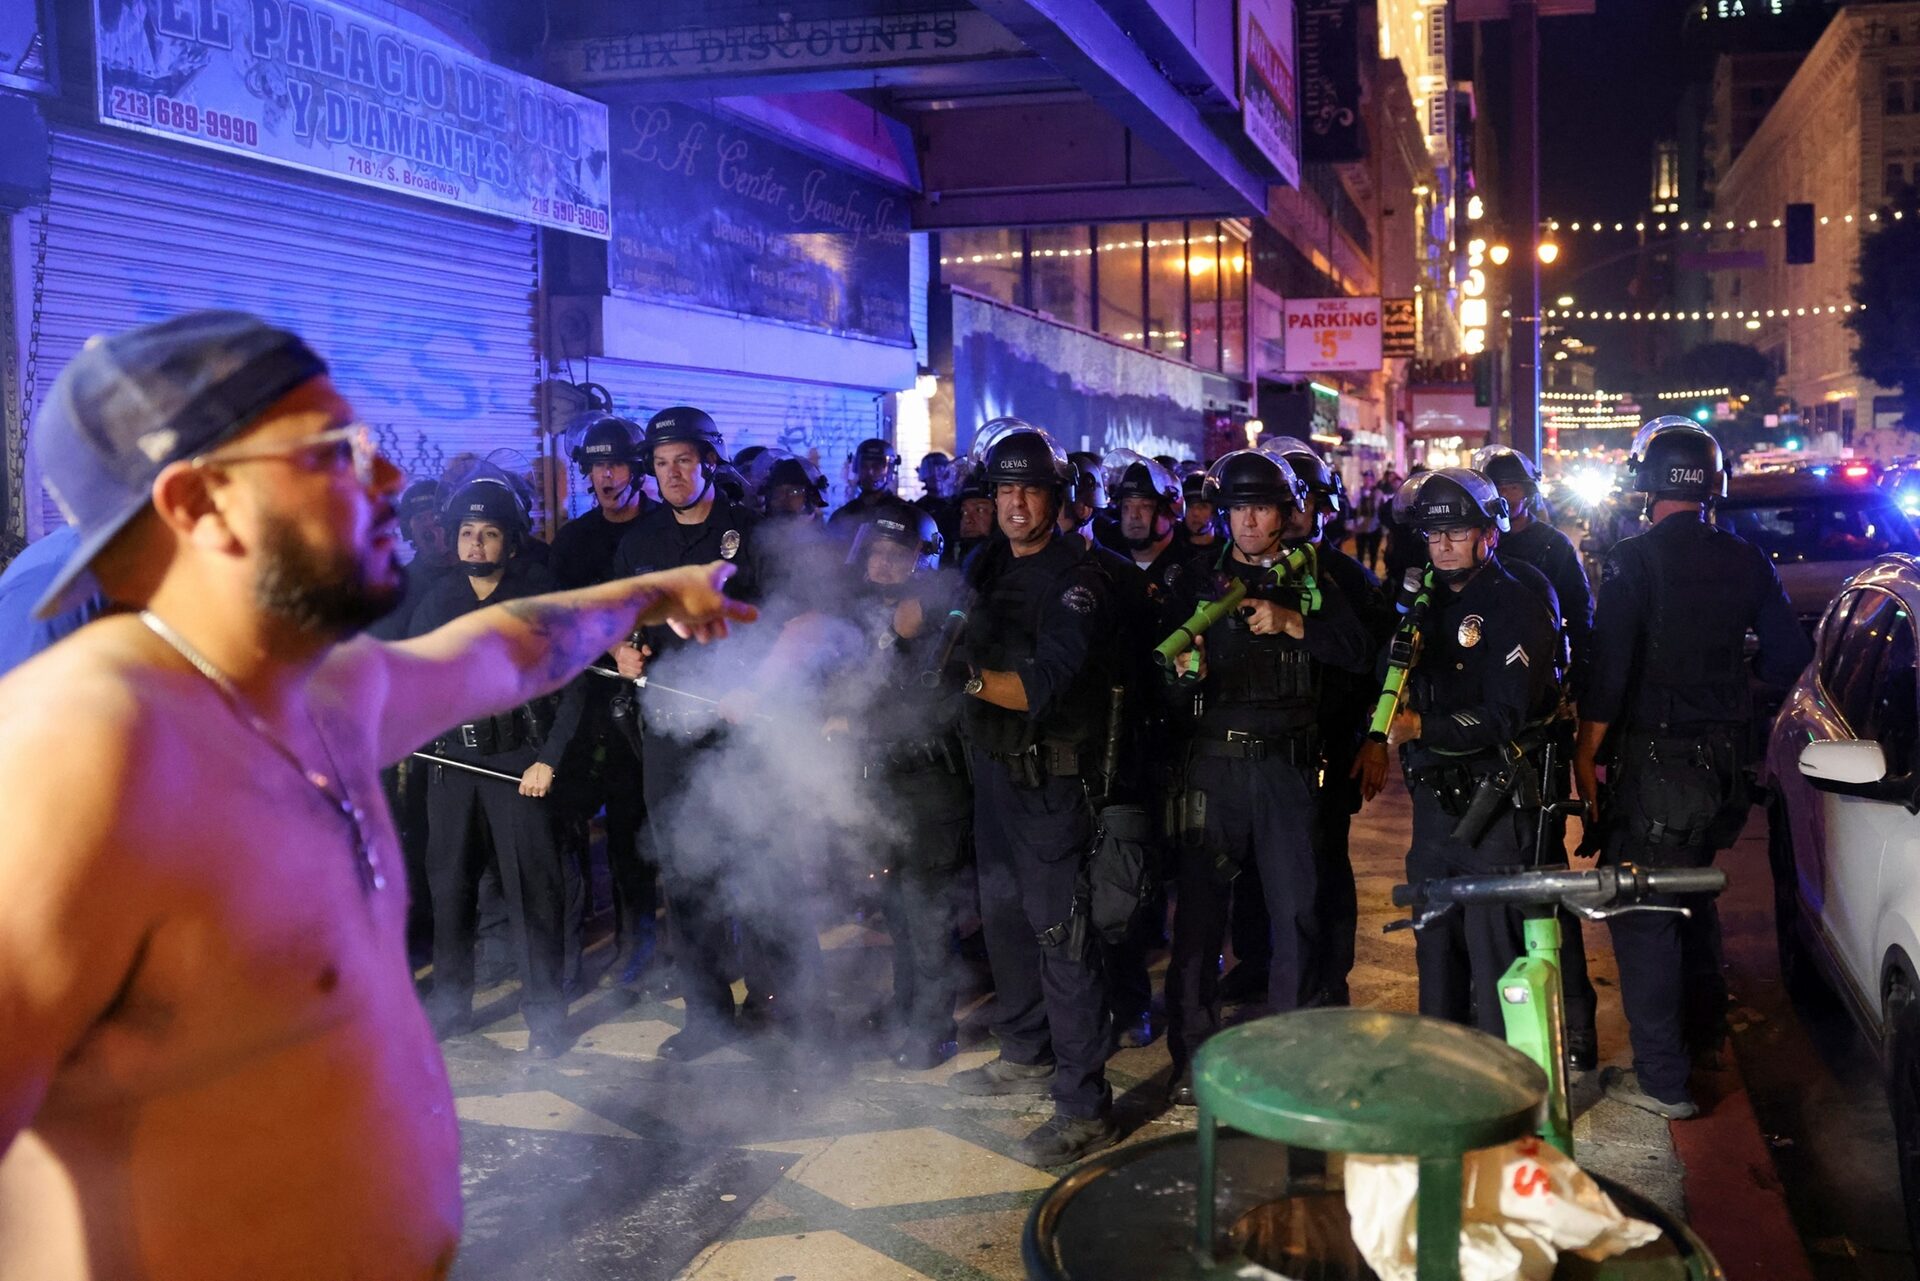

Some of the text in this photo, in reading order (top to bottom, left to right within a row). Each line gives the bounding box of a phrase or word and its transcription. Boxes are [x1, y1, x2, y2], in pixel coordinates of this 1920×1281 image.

[582, 18, 958, 73] FELIX DISCOUNTS
[157, 0, 582, 161] EL PALACIO DE ORO
[113, 87, 258, 147] 213 689-9990
[287, 78, 513, 190] Y DIAMANTES
[387, 166, 399, 182] S.
[403, 170, 460, 200] Broadway
[1288, 311, 1378, 329] PARKING
[1000, 459, 1028, 469] CUEVAS
[1670, 468, 1704, 484] 37440
